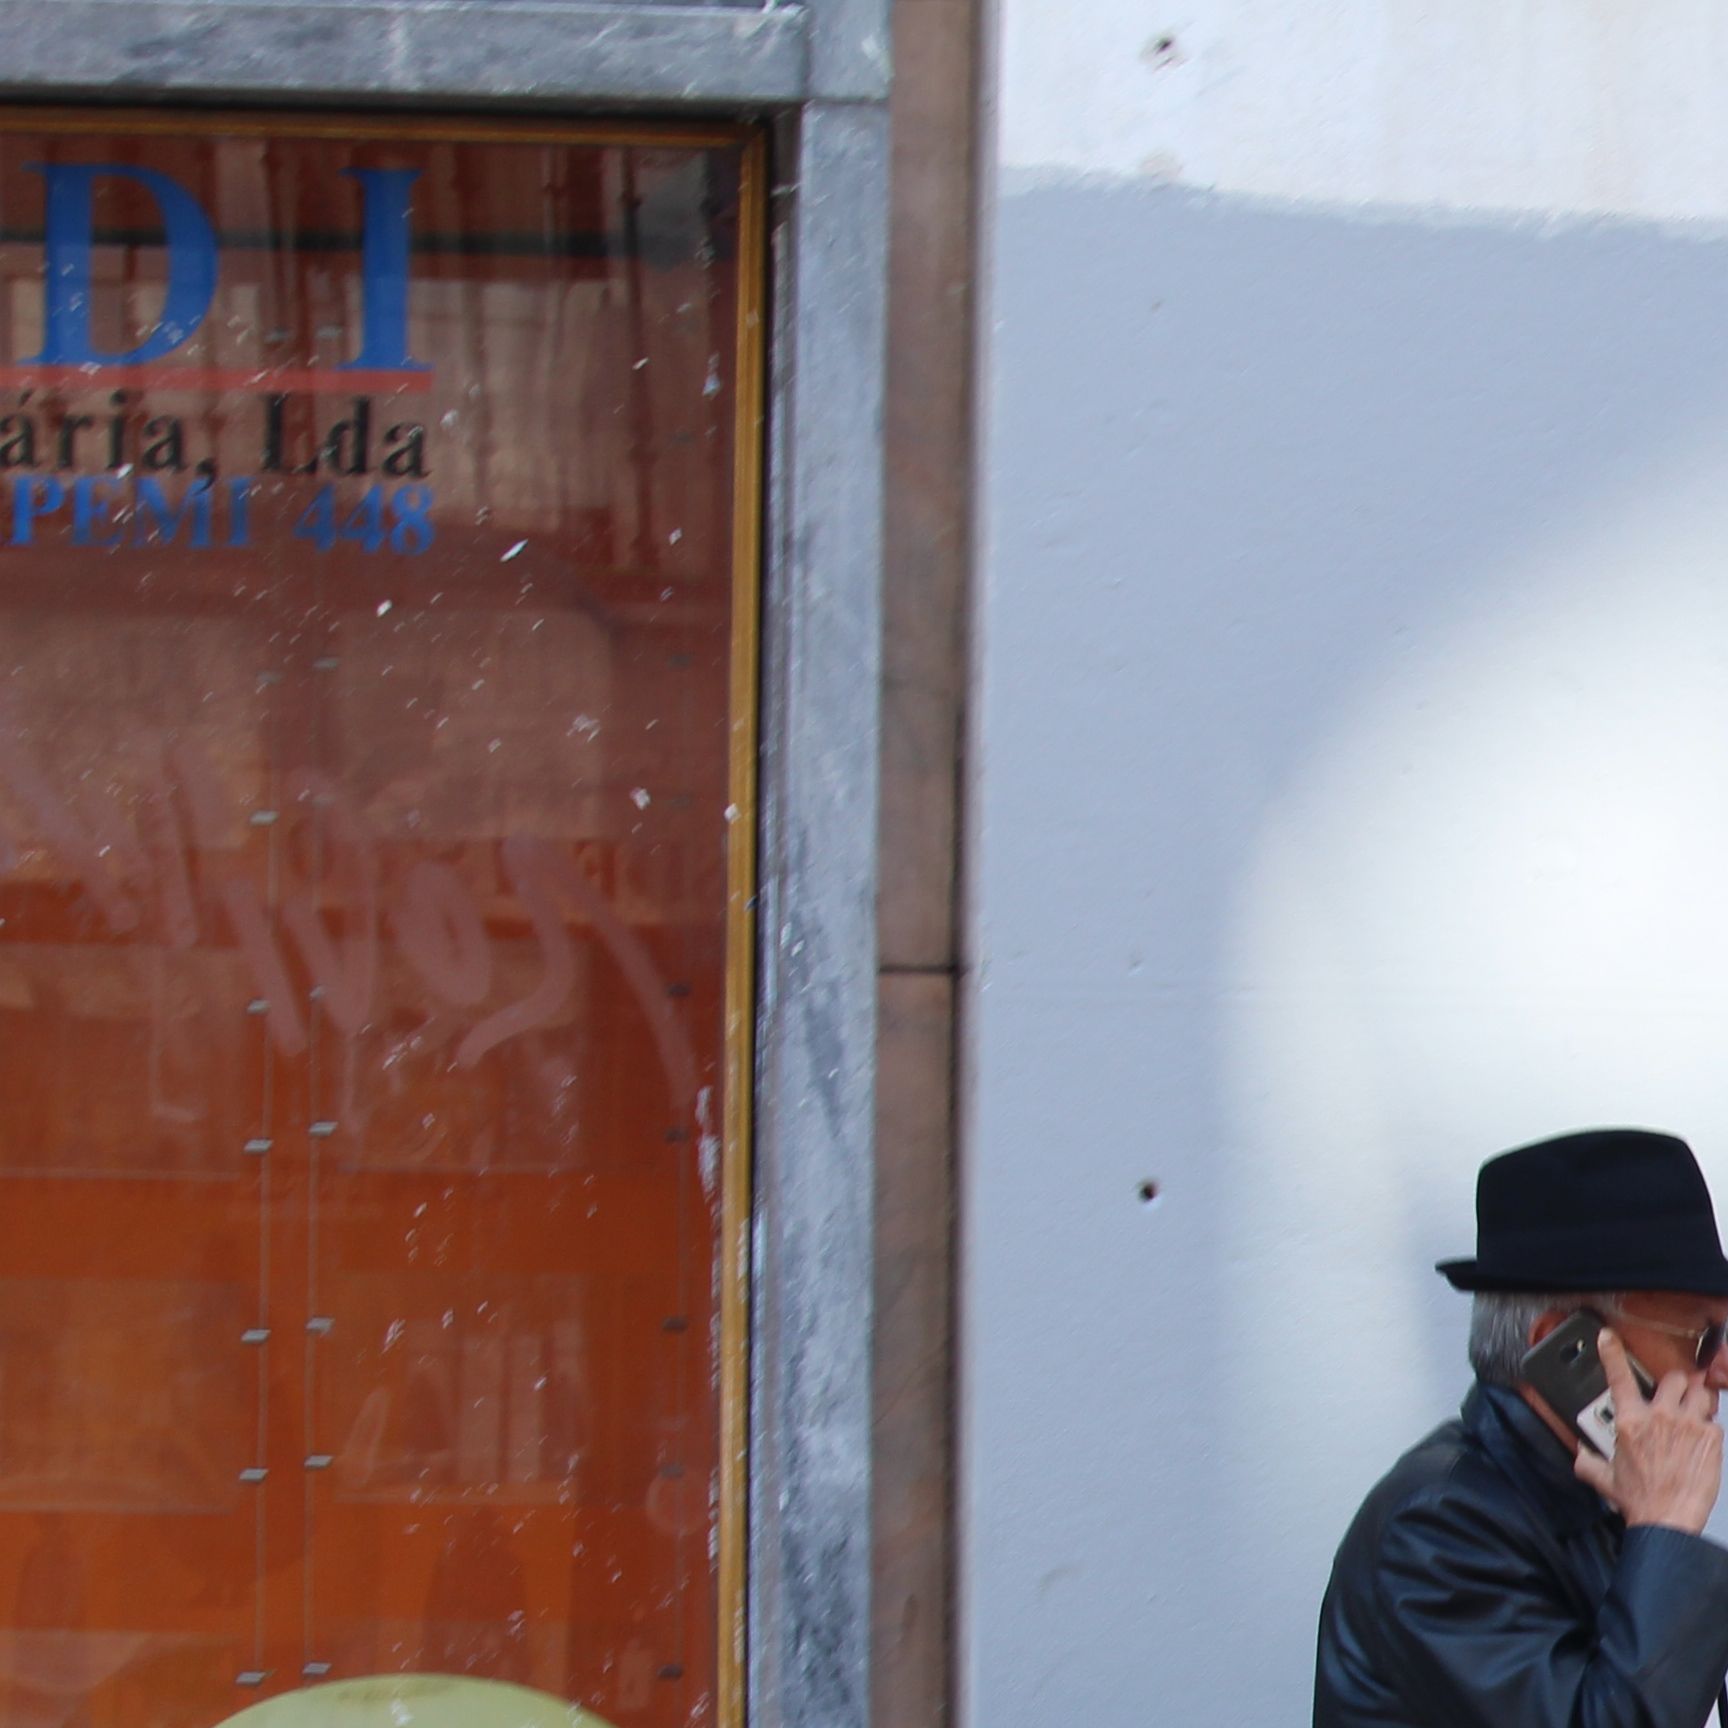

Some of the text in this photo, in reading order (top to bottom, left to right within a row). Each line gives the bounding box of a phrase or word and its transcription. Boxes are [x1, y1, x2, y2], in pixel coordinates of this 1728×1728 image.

[0, 389, 431, 495] ária, Lda
[293, 483, 437, 557] 448
